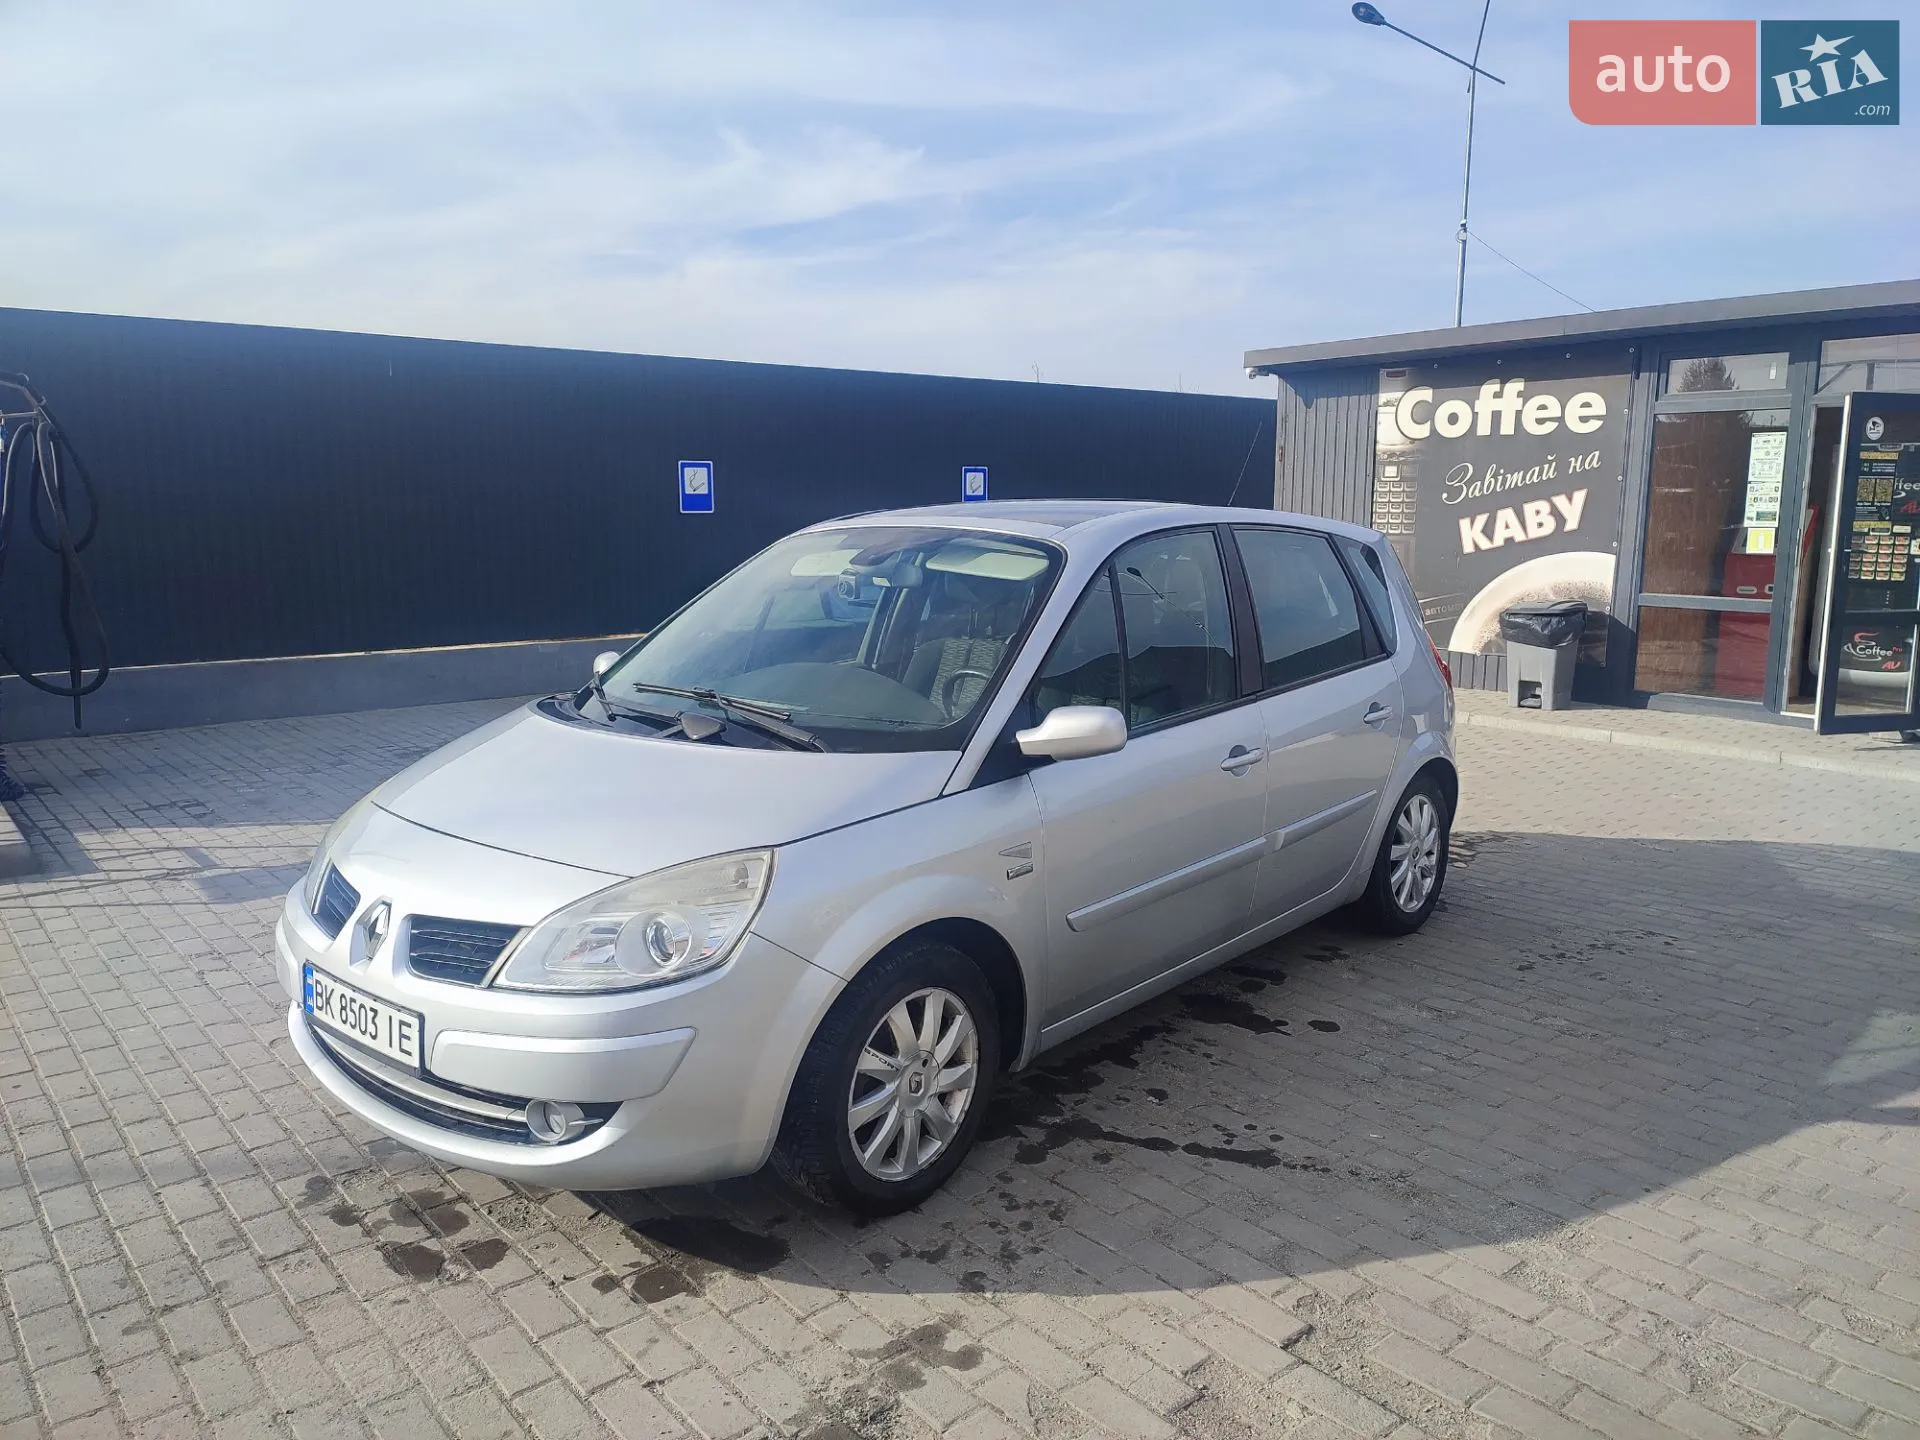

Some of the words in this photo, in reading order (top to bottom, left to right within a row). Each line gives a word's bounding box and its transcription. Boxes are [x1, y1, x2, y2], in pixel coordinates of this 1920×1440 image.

[1396, 378, 1607, 440] Coffee
[1441, 453, 1558, 505] Завітай
[1568, 449, 1602, 476] на
[1894, 477, 1920, 490] ffee
[1458, 488, 1589, 554] КАВУ
[1856, 645, 1893, 656] Coffee
[315, 979, 335, 1019] BK
[340, 993, 378, 1040] 8503
[388, 1014, 413, 1057] IE
